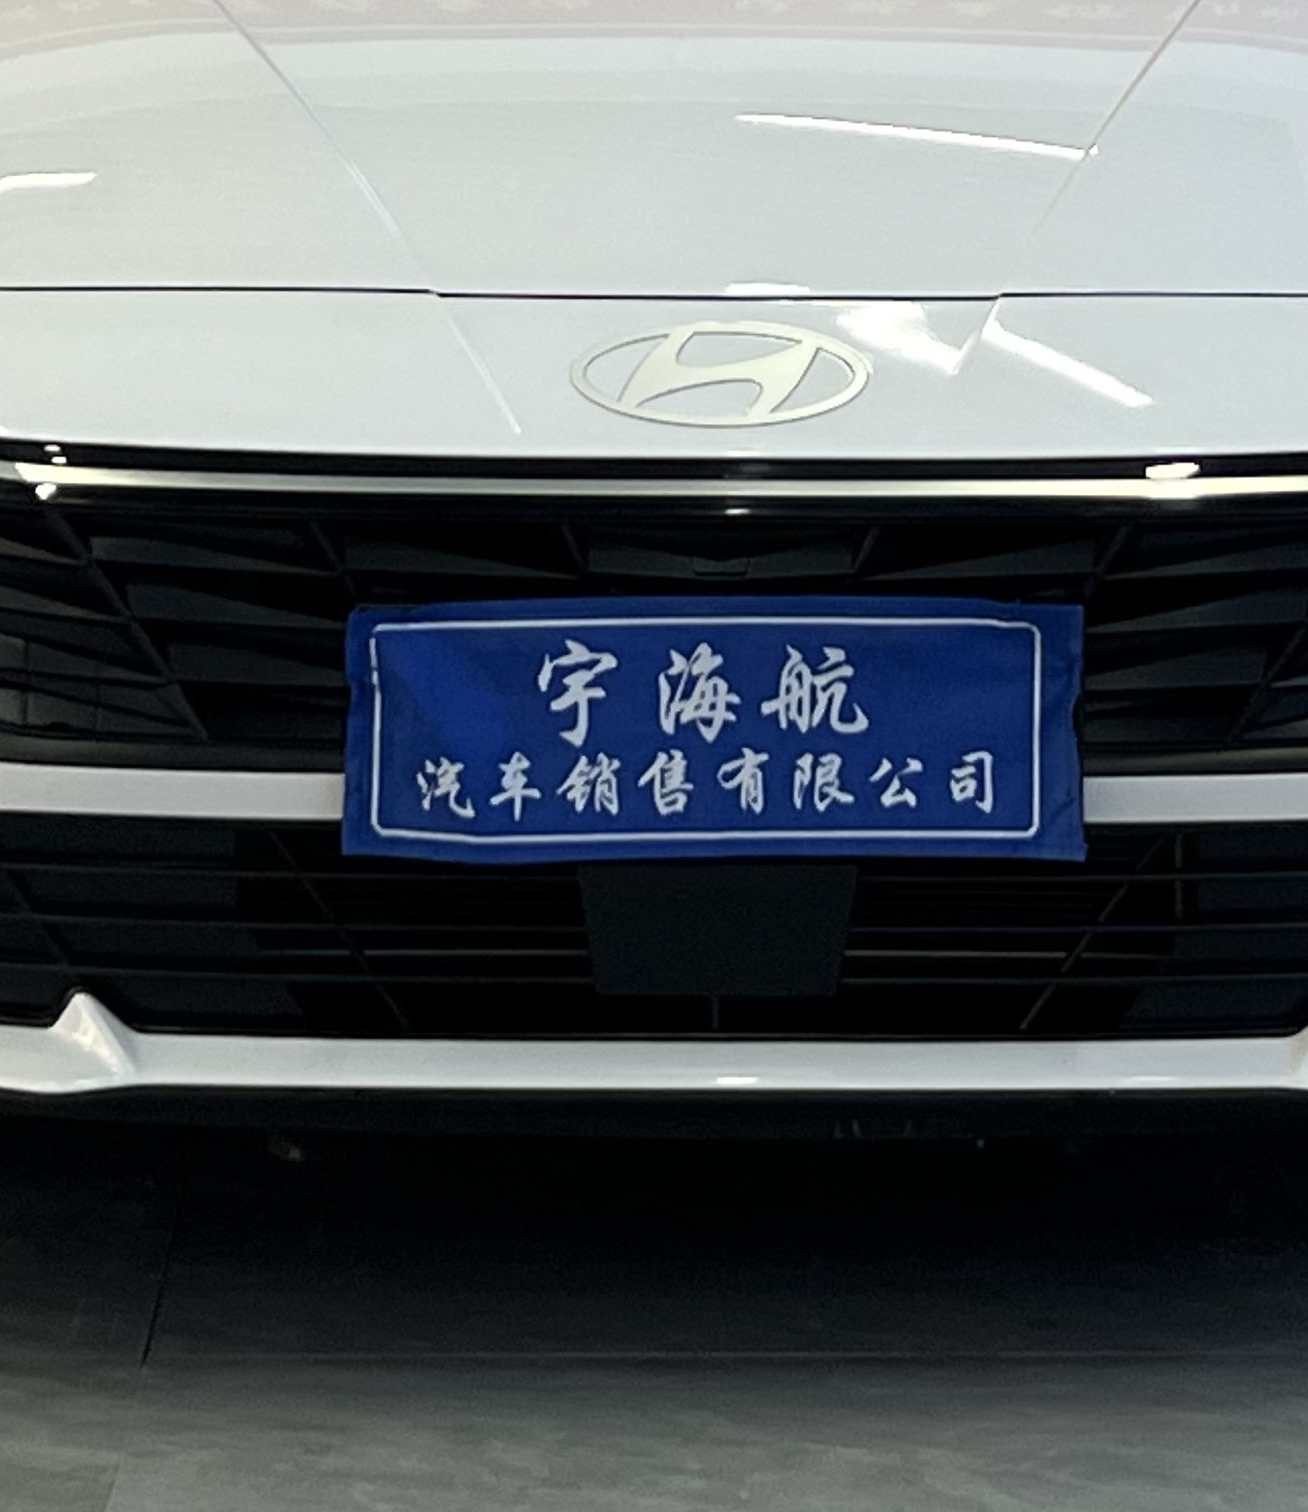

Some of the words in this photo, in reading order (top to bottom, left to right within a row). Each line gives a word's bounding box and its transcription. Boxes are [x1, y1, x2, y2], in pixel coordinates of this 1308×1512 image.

[536, 639, 870, 748] 宇海航
[416, 747, 996, 823] 汽车销售有限公司
